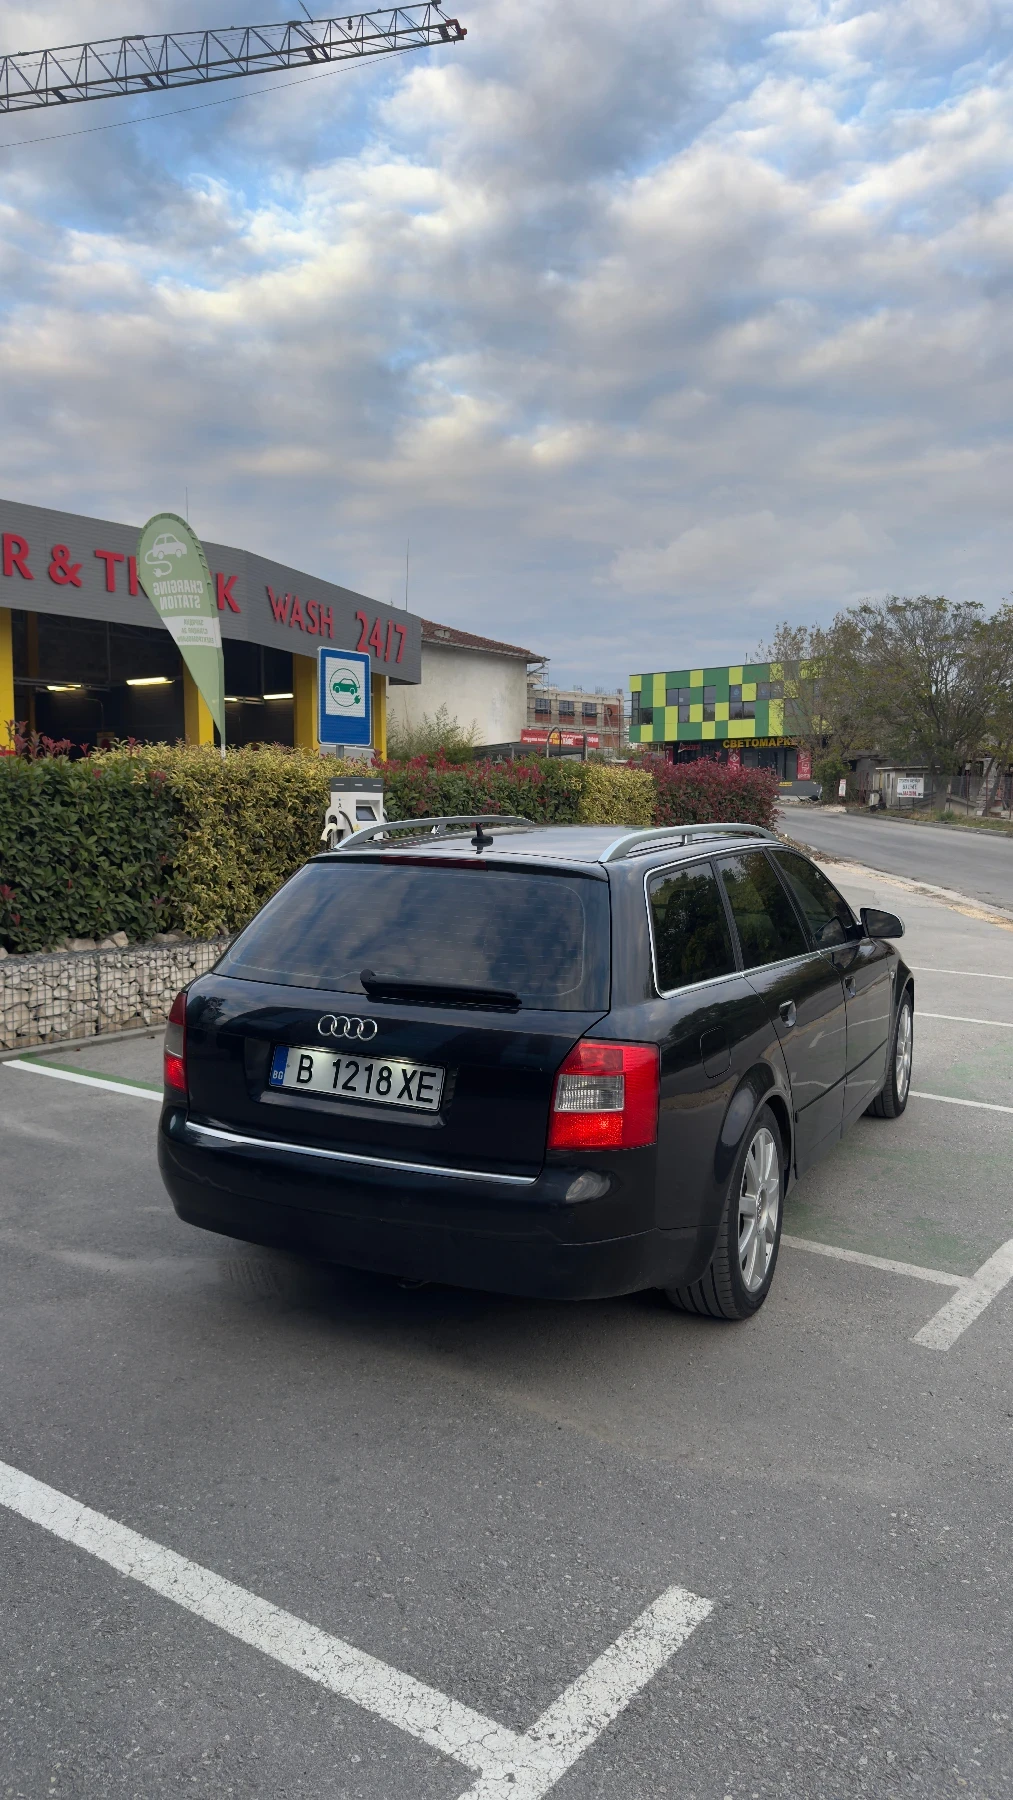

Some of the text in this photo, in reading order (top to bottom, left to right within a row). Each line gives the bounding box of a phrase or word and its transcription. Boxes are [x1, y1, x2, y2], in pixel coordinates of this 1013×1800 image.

[48, 544, 83, 588] &
[266, 585, 334, 639] WASH
[355, 609, 408, 663] 24/7
[272, 1070, 284, 1080] BG
[296, 1054, 314, 1083] B
